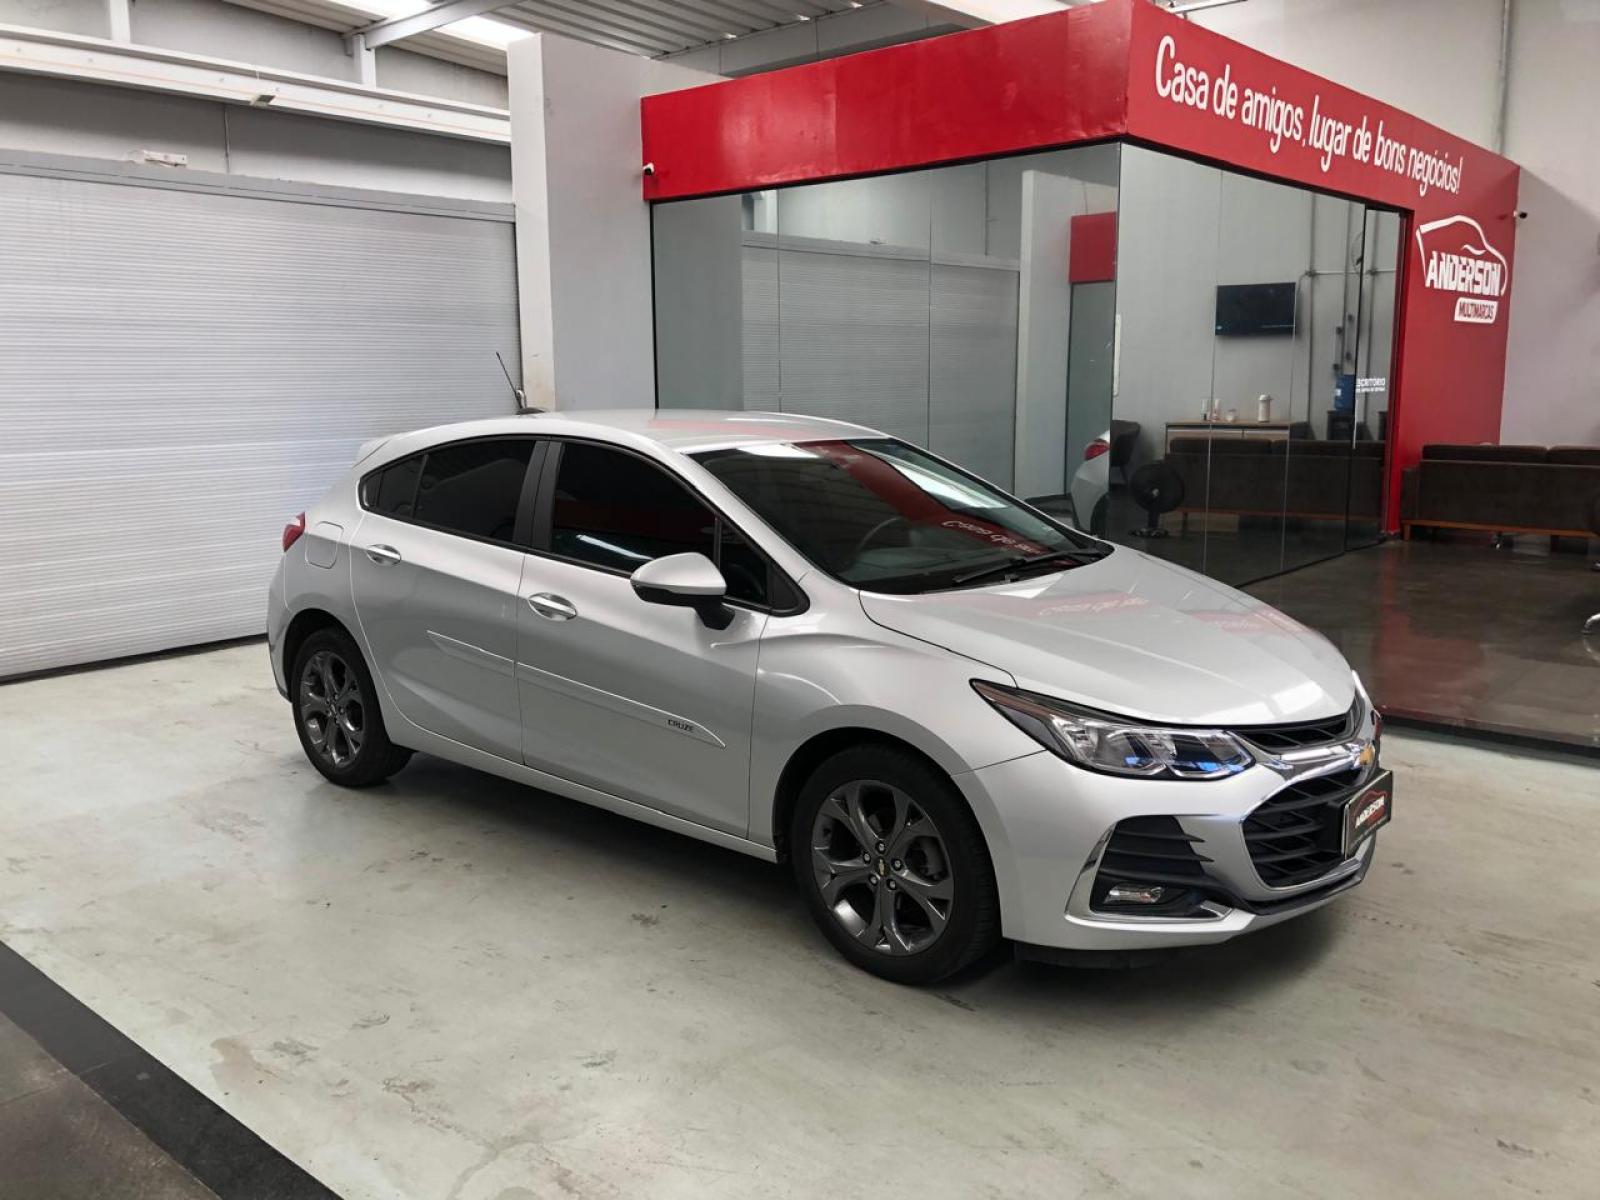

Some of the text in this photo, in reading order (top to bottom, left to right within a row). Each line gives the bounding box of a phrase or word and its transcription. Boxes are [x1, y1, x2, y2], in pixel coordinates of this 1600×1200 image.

[1155, 35, 1463, 197] Casa de amigos, lugar de bons negócios!
[1425, 251, 1501, 297] ANDERSON
[1458, 301, 1495, 320] MULTIMARCAS
[668, 719, 694, 731] CRUZE
